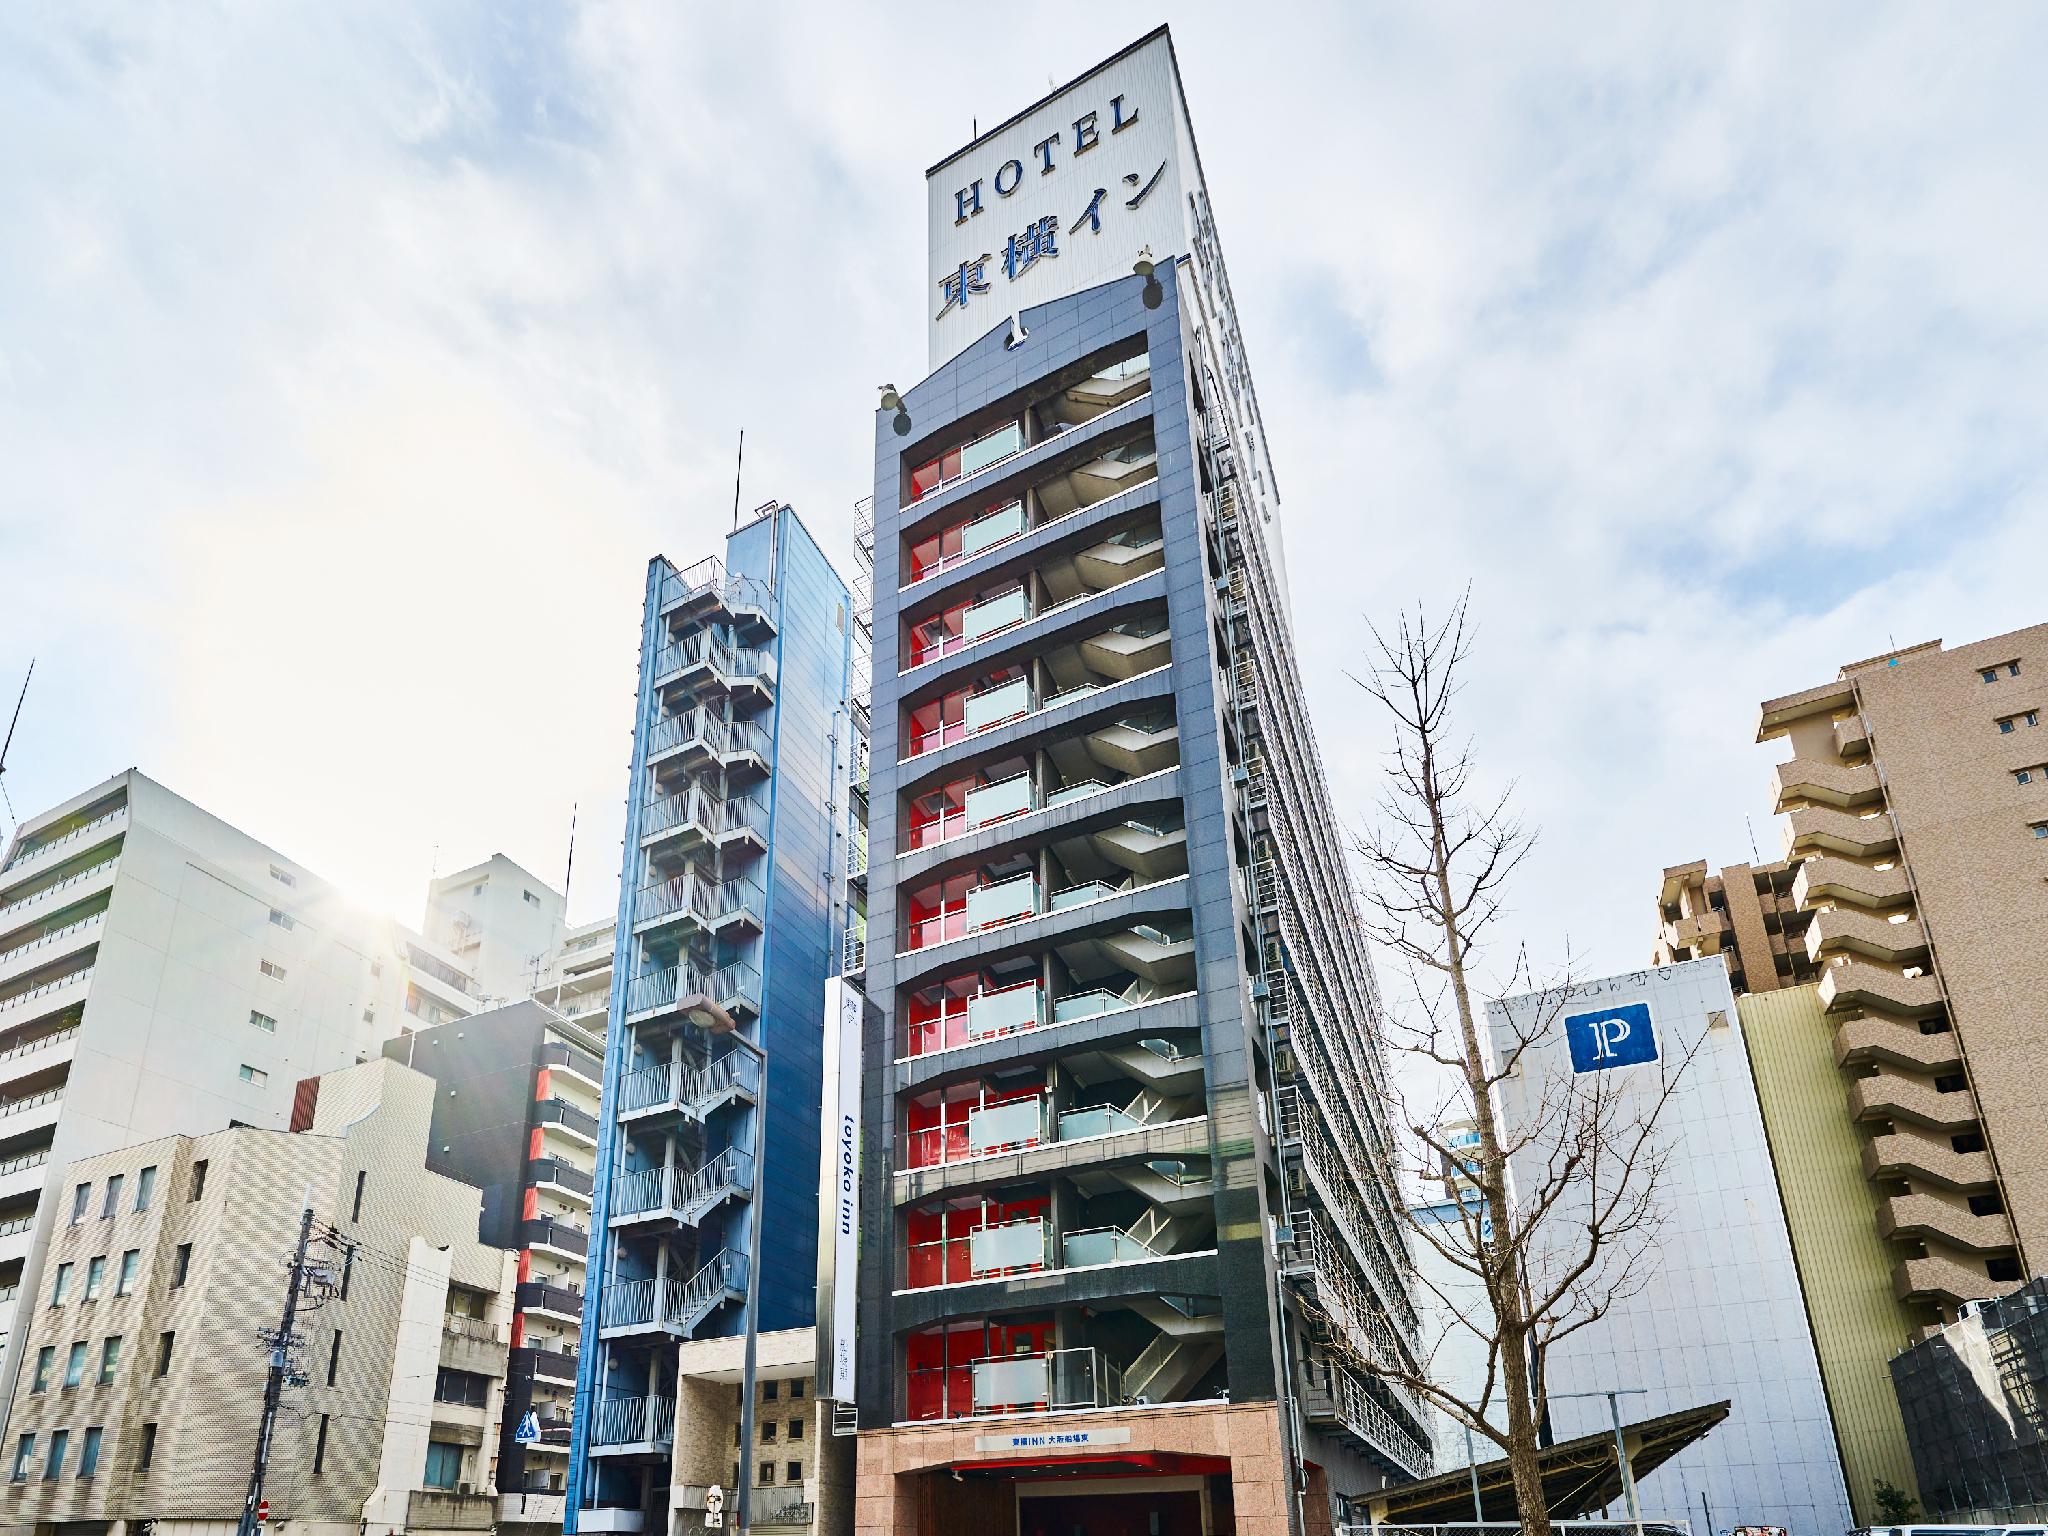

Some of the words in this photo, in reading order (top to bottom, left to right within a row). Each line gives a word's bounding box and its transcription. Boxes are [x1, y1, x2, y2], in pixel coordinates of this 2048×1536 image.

[955, 94, 1139, 227] HOTEL
[936, 159, 1167, 321] 東横イン
[1588, 1018, 1631, 1061] P
[841, 1114, 855, 1193] toyoko
[842, 1198, 854, 1235] inn
